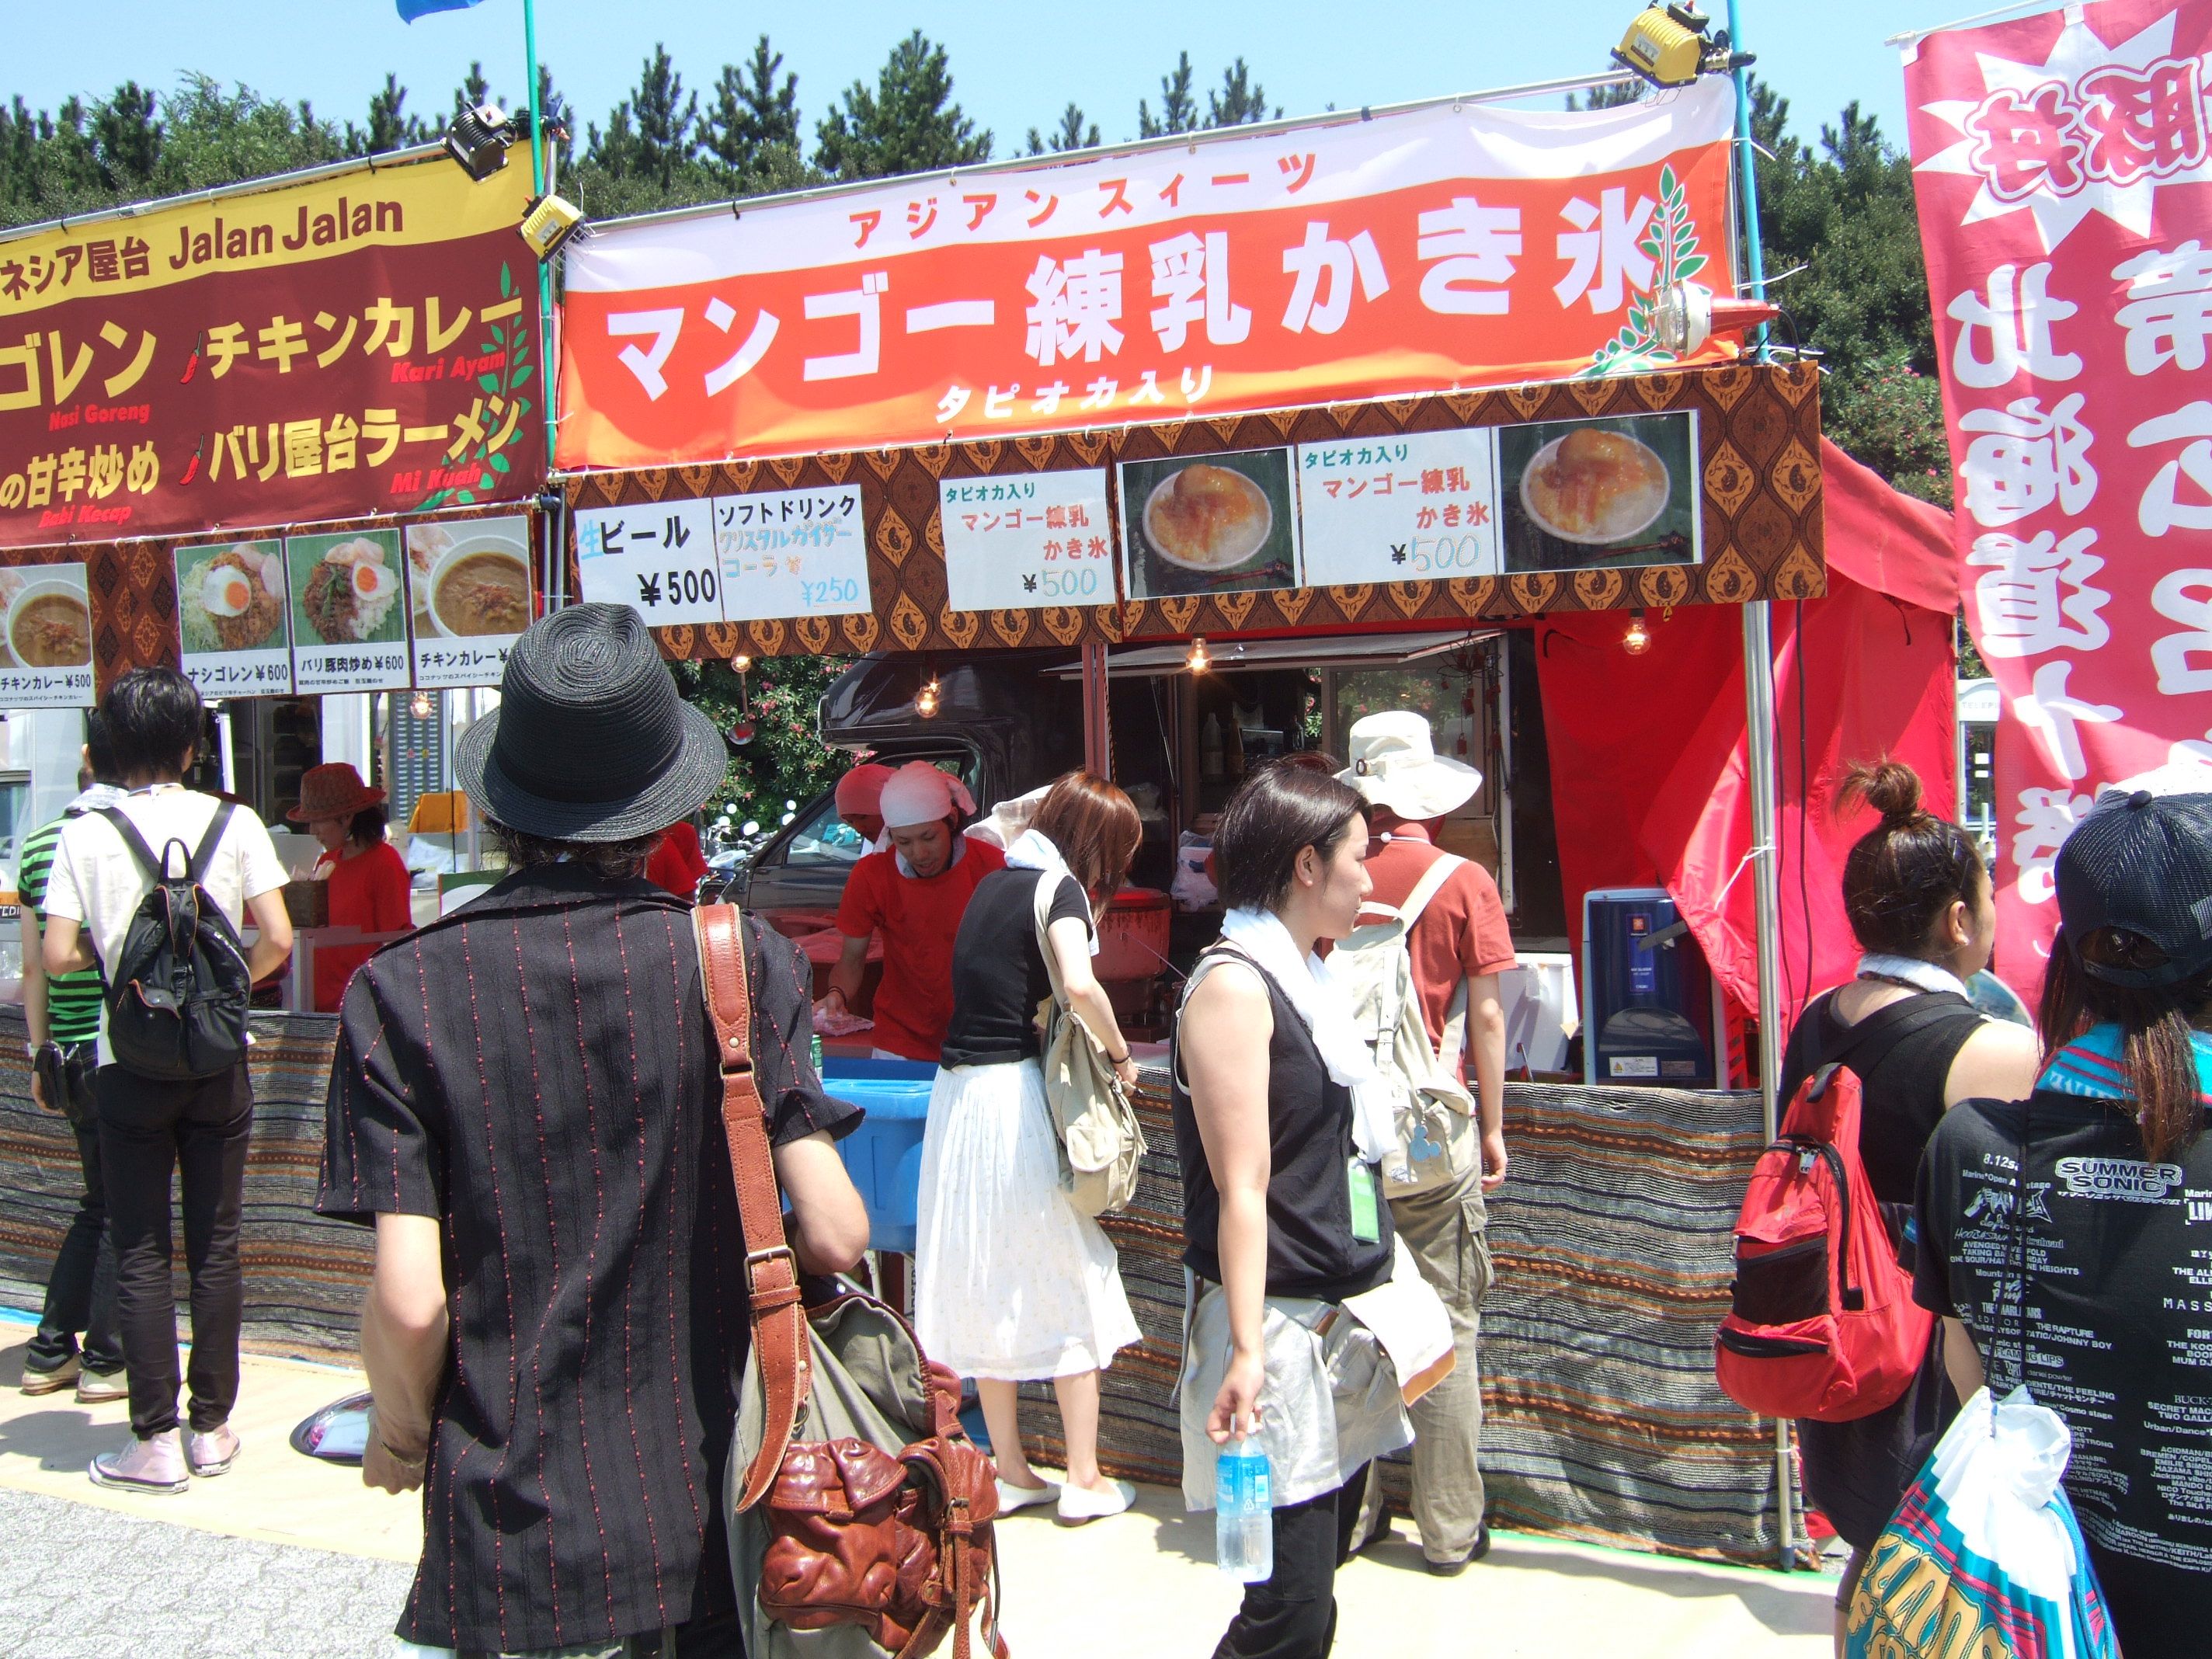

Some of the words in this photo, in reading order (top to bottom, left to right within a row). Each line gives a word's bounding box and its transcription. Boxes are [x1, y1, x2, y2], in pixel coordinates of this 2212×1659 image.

[169, 217, 274, 270] Jalan
[282, 196, 404, 251] Jalan
[607, 186, 1657, 403] マンゴー練乳かき氷
[207, 296, 523, 380] チキンカレー
[391, 360, 444, 384] Kari
[449, 350, 507, 381] Ayam
[936, 364, 1213, 424] タピオカ入り
[48, 409, 80, 432] Nasi
[84, 402, 151, 425] Goreng
[207, 394, 522, 483] バリ屋台ラーメン
[1305, 443, 1408, 469] タピオカ入り
[0, 440, 160, 511] の甘辛炒め
[390, 470, 419, 496] Mi
[426, 463, 483, 490] Kuah
[1322, 466, 1470, 499] マンゴー練乳
[946, 482, 1036, 504] タピオカ入り
[77, 505, 133, 526] Kecap
[718, 494, 856, 527] ソフトドリンク
[961, 504, 1090, 533] マンゴー練乳
[1415, 501, 1490, 530] かき氷
[1042, 534, 1109, 562] かき氷
[1389, 534, 1482, 572] ¥500
[637, 567, 717, 607] ¥500
[801, 577, 859, 608] ¥250
[1021, 567, 1099, 598] ¥500
[2061, 1162, 2175, 1181] SUMMER
[2072, 1176, 2162, 1193] SONIC
